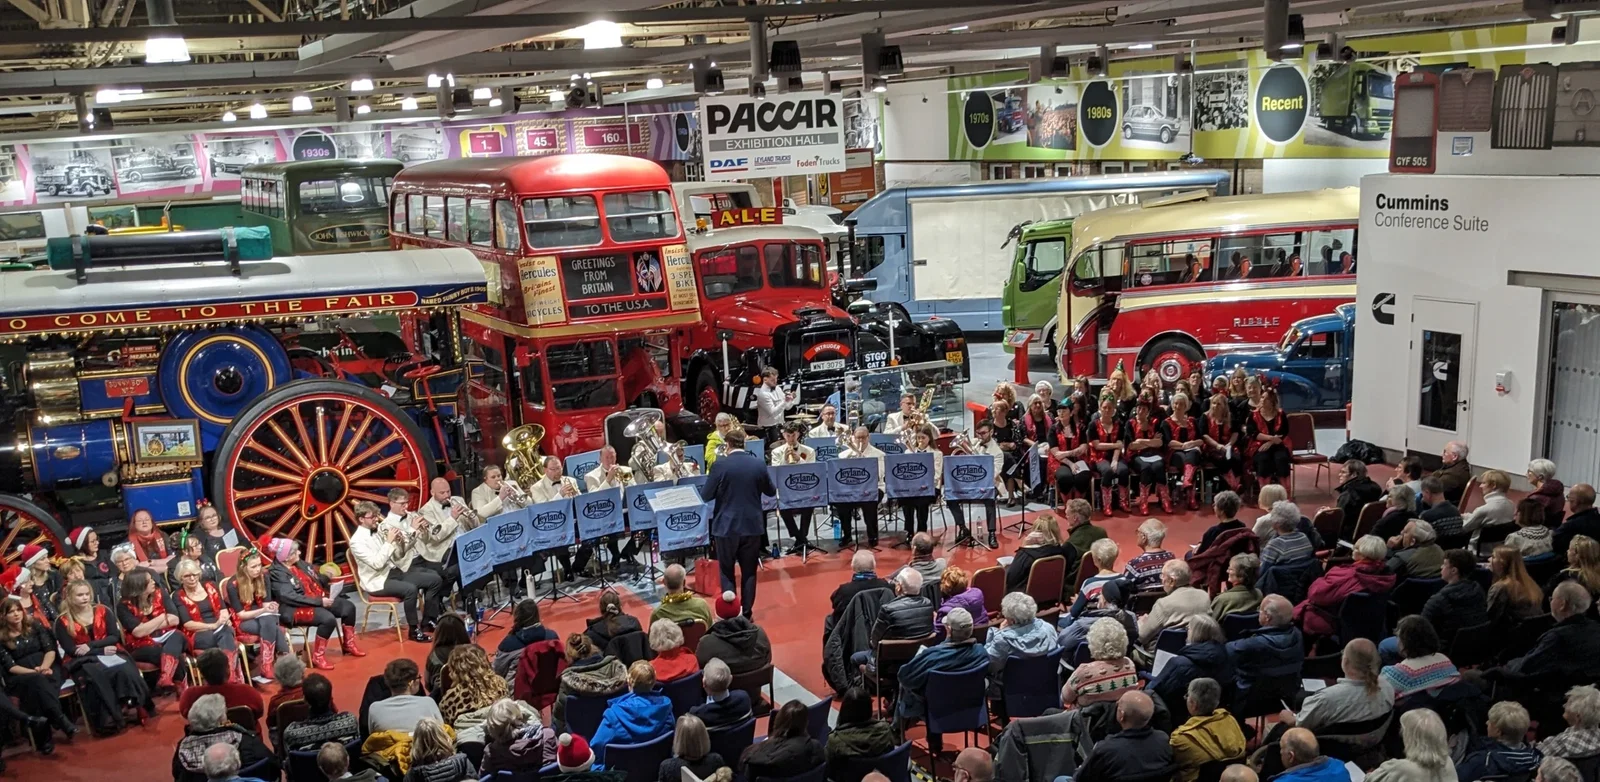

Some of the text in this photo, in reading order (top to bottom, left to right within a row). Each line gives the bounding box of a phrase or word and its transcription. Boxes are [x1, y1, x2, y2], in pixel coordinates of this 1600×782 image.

[1261, 96, 1303, 111] Recent
[706, 99, 838, 135] PACCAR
[969, 113, 989, 125] 1970s
[1087, 106, 1112, 119] 1980s
[534, 137, 547, 147] 45
[602, 133, 619, 143] 160
[726, 135, 824, 150] EXHIBITION HALL
[301, 148, 330, 157] 1930s
[710, 158, 749, 169] DAF
[797, 157, 840, 168] Foden Trucks
[1396, 157, 1427, 166] GYF 505
[1376, 194, 1449, 212] Cummins
[1374, 212, 1489, 232] Conference Suite
[571, 256, 616, 271] GREETINGS
[584, 270, 607, 282] FROM
[581, 281, 614, 295] BRITAIN
[442, 290, 461, 302] SUNNY
[54, 310, 152, 327] COME
[175, 306, 217, 320] TO
[240, 300, 303, 315] THE
[325, 294, 396, 310] FAIR
[584, 304, 600, 315] TO
[601, 302, 624, 313] THE
[814, 343, 842, 352] INTRUDER
[865, 351, 887, 362] STGO
[813, 362, 825, 371] WNT
[840, 467, 866, 480] Leyland
[897, 462, 923, 475] Leyland
[957, 463, 983, 477] Leyland
[789, 472, 816, 485] Leyland
[586, 498, 612, 514] Leyland
[537, 510, 563, 526] Leyland
[669, 511, 697, 528] Leyland
[498, 521, 521, 537] Leyland
